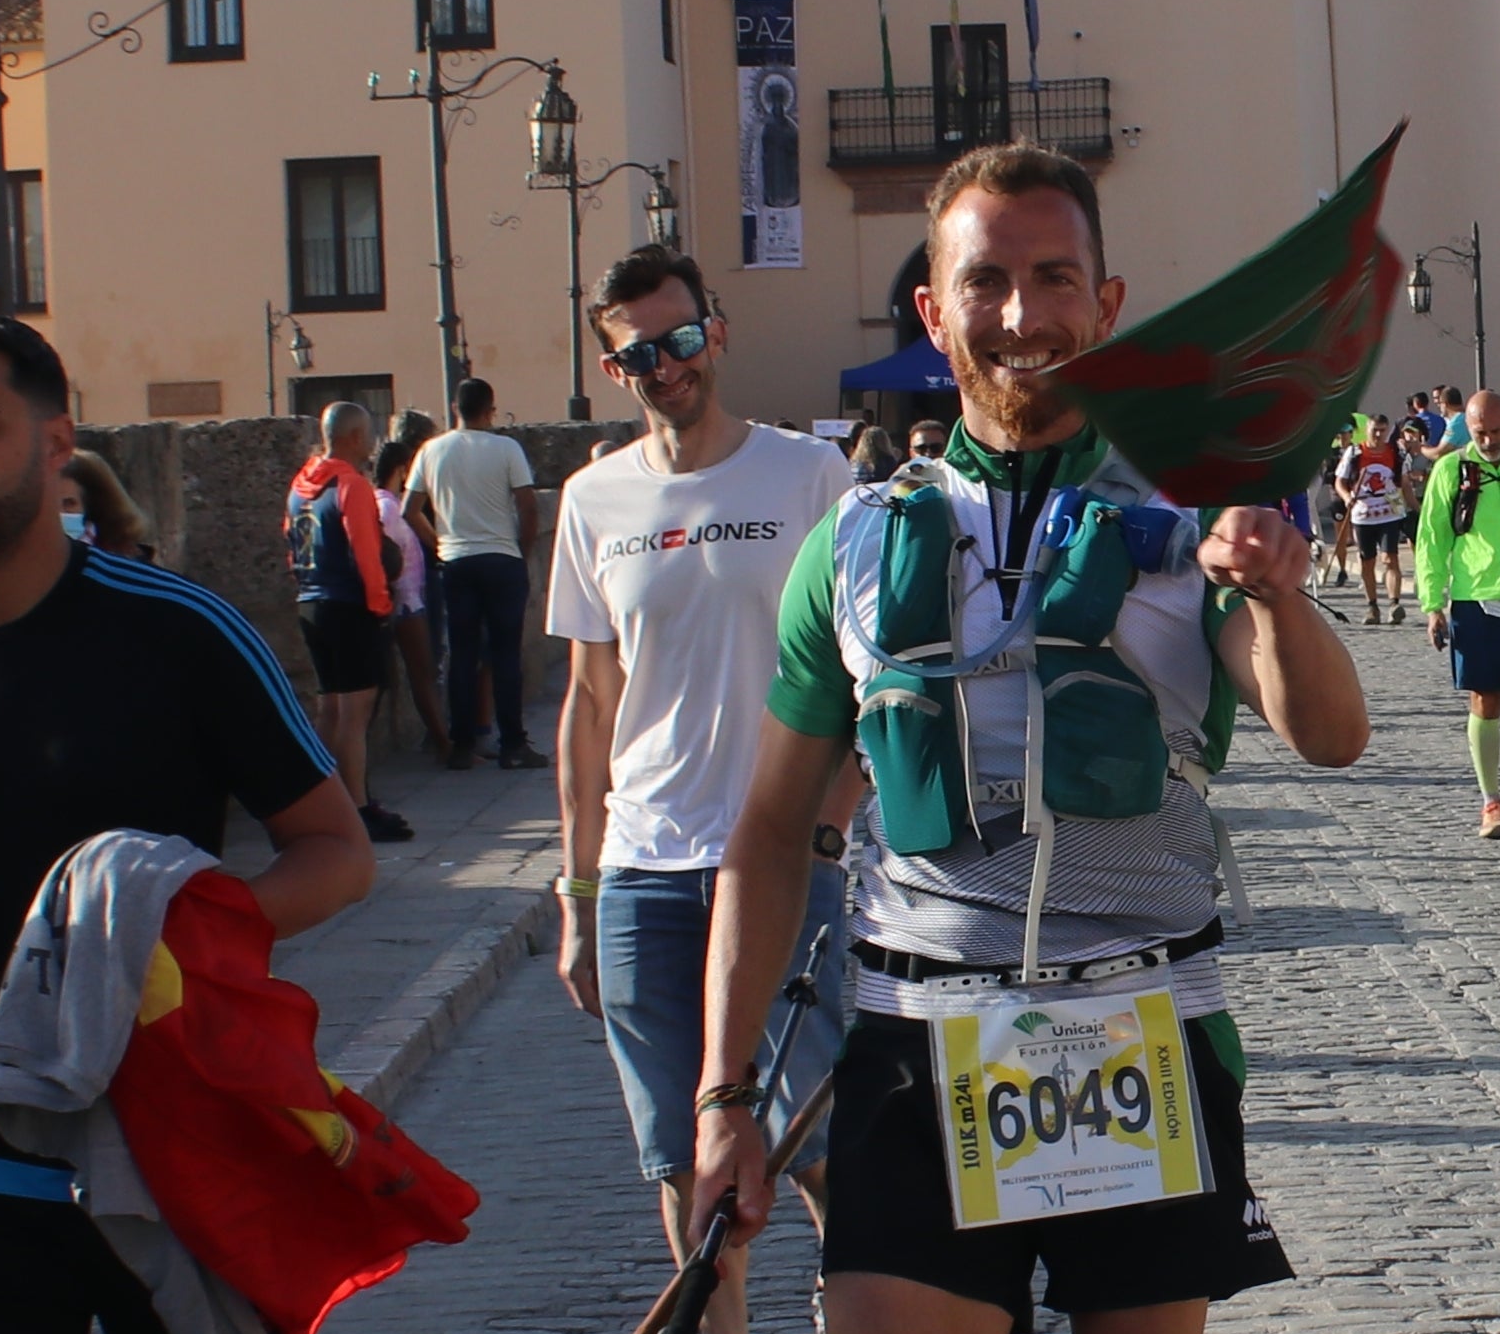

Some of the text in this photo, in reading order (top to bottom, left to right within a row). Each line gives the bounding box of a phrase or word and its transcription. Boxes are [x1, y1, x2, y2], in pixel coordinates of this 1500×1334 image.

[736, 16, 793, 43] PAZ
[601, 532, 660, 562] JACK
[1051, 1018, 1106, 1037] Unicaja
[1018, 1041, 1107, 1058] Fundación
[1157, 1045, 1182, 1140] XXIII EDICIÓN
[987, 1066, 1152, 1150] 6049
